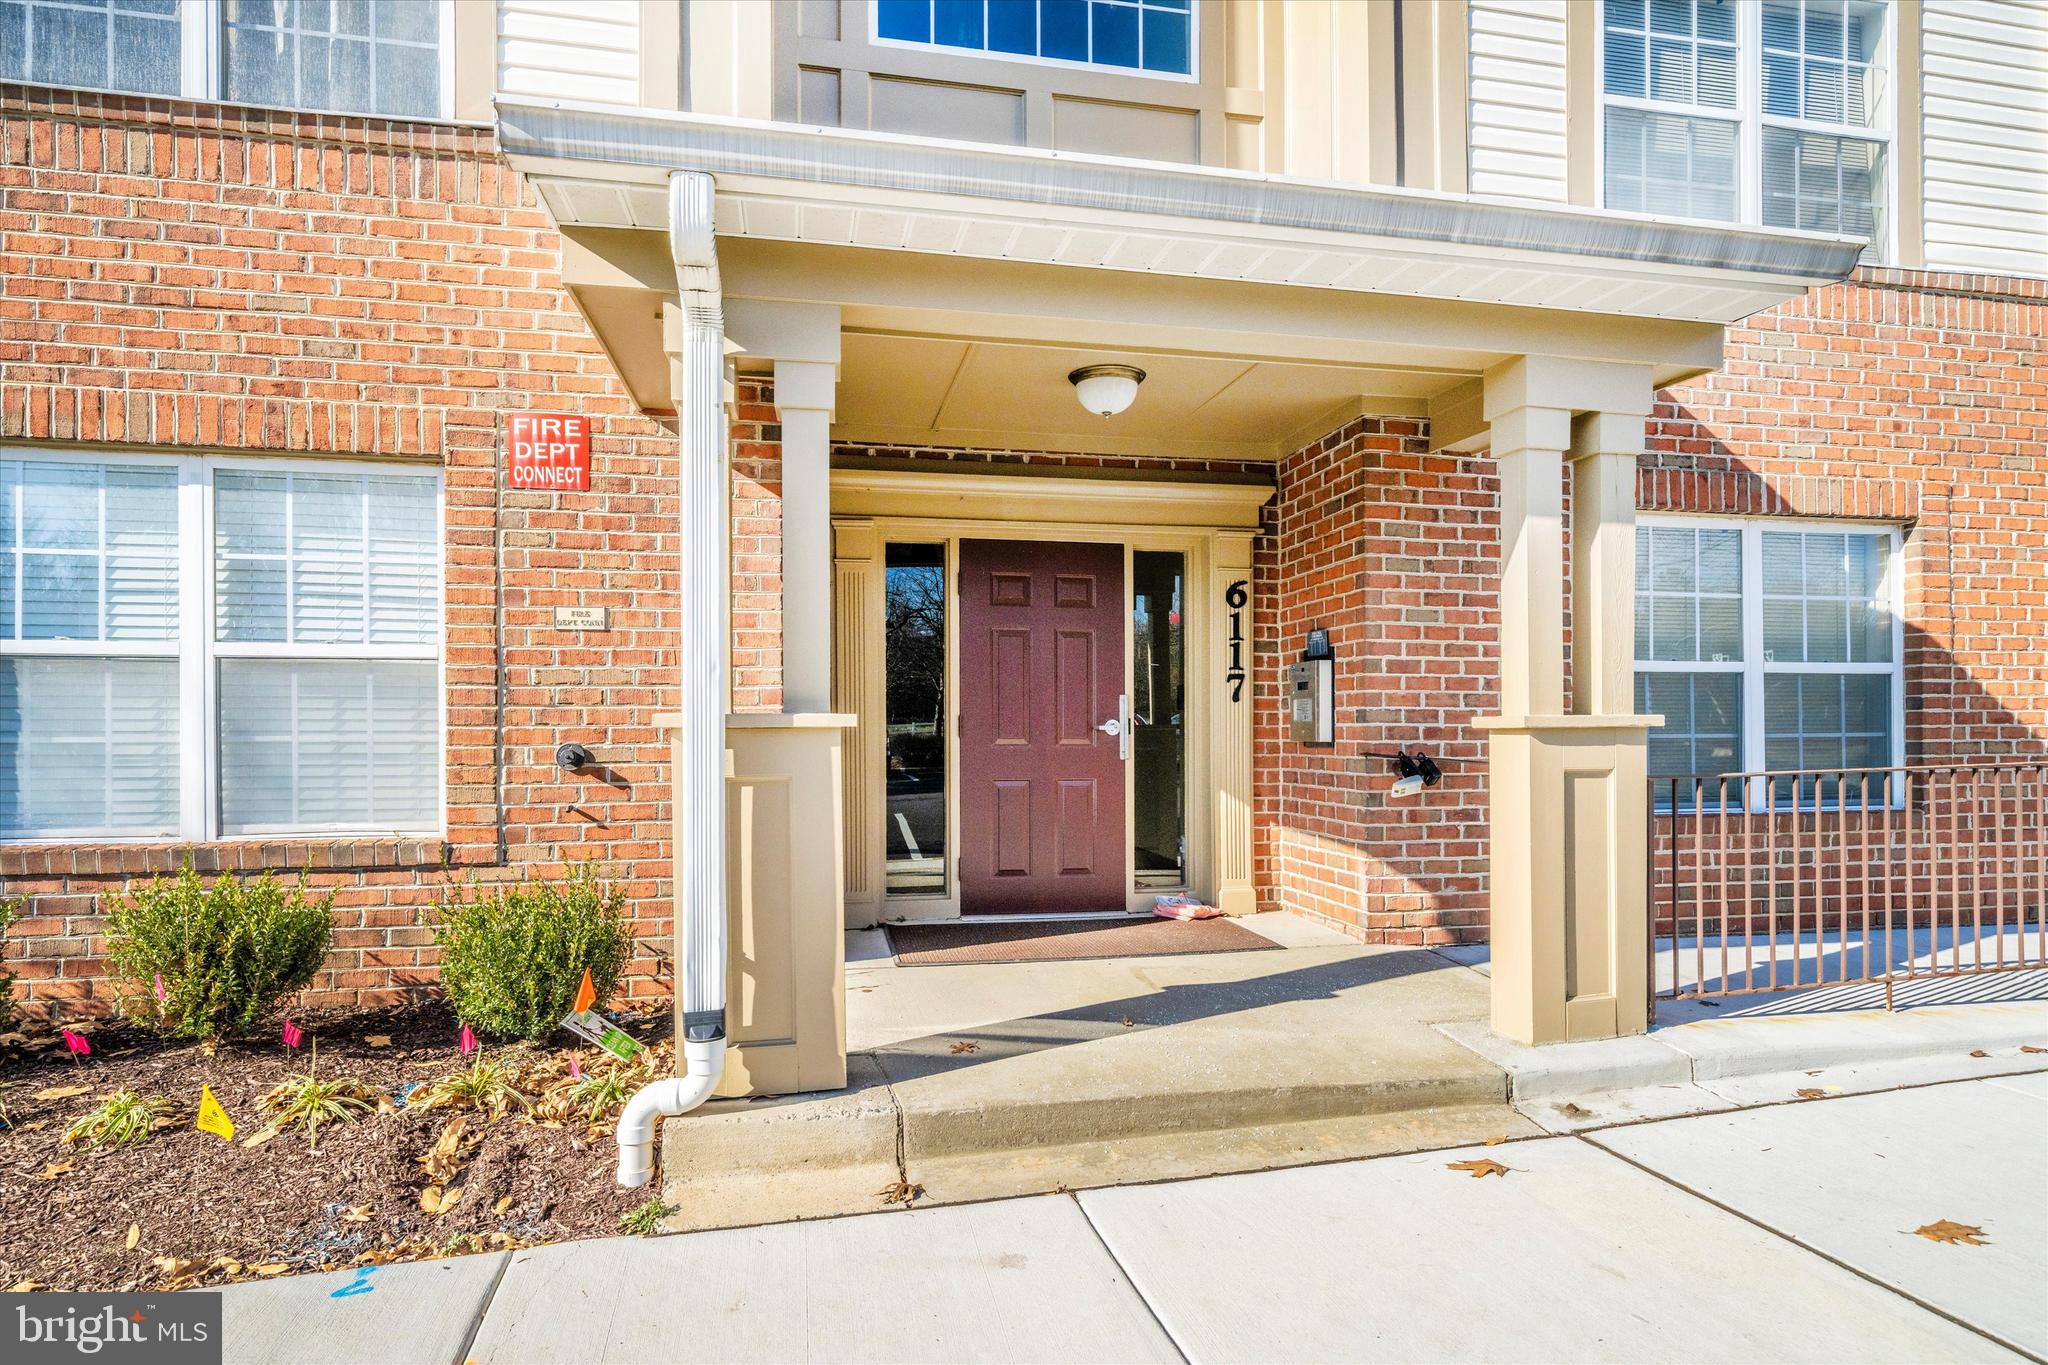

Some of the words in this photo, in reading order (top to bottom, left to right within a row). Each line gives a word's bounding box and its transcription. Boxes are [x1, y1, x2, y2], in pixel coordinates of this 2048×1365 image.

[513, 417, 582, 437] FIRE
[515, 441, 580, 461] DEPT
[513, 465, 583, 484] CONNECT
[1225, 580, 1248, 703] 6117
